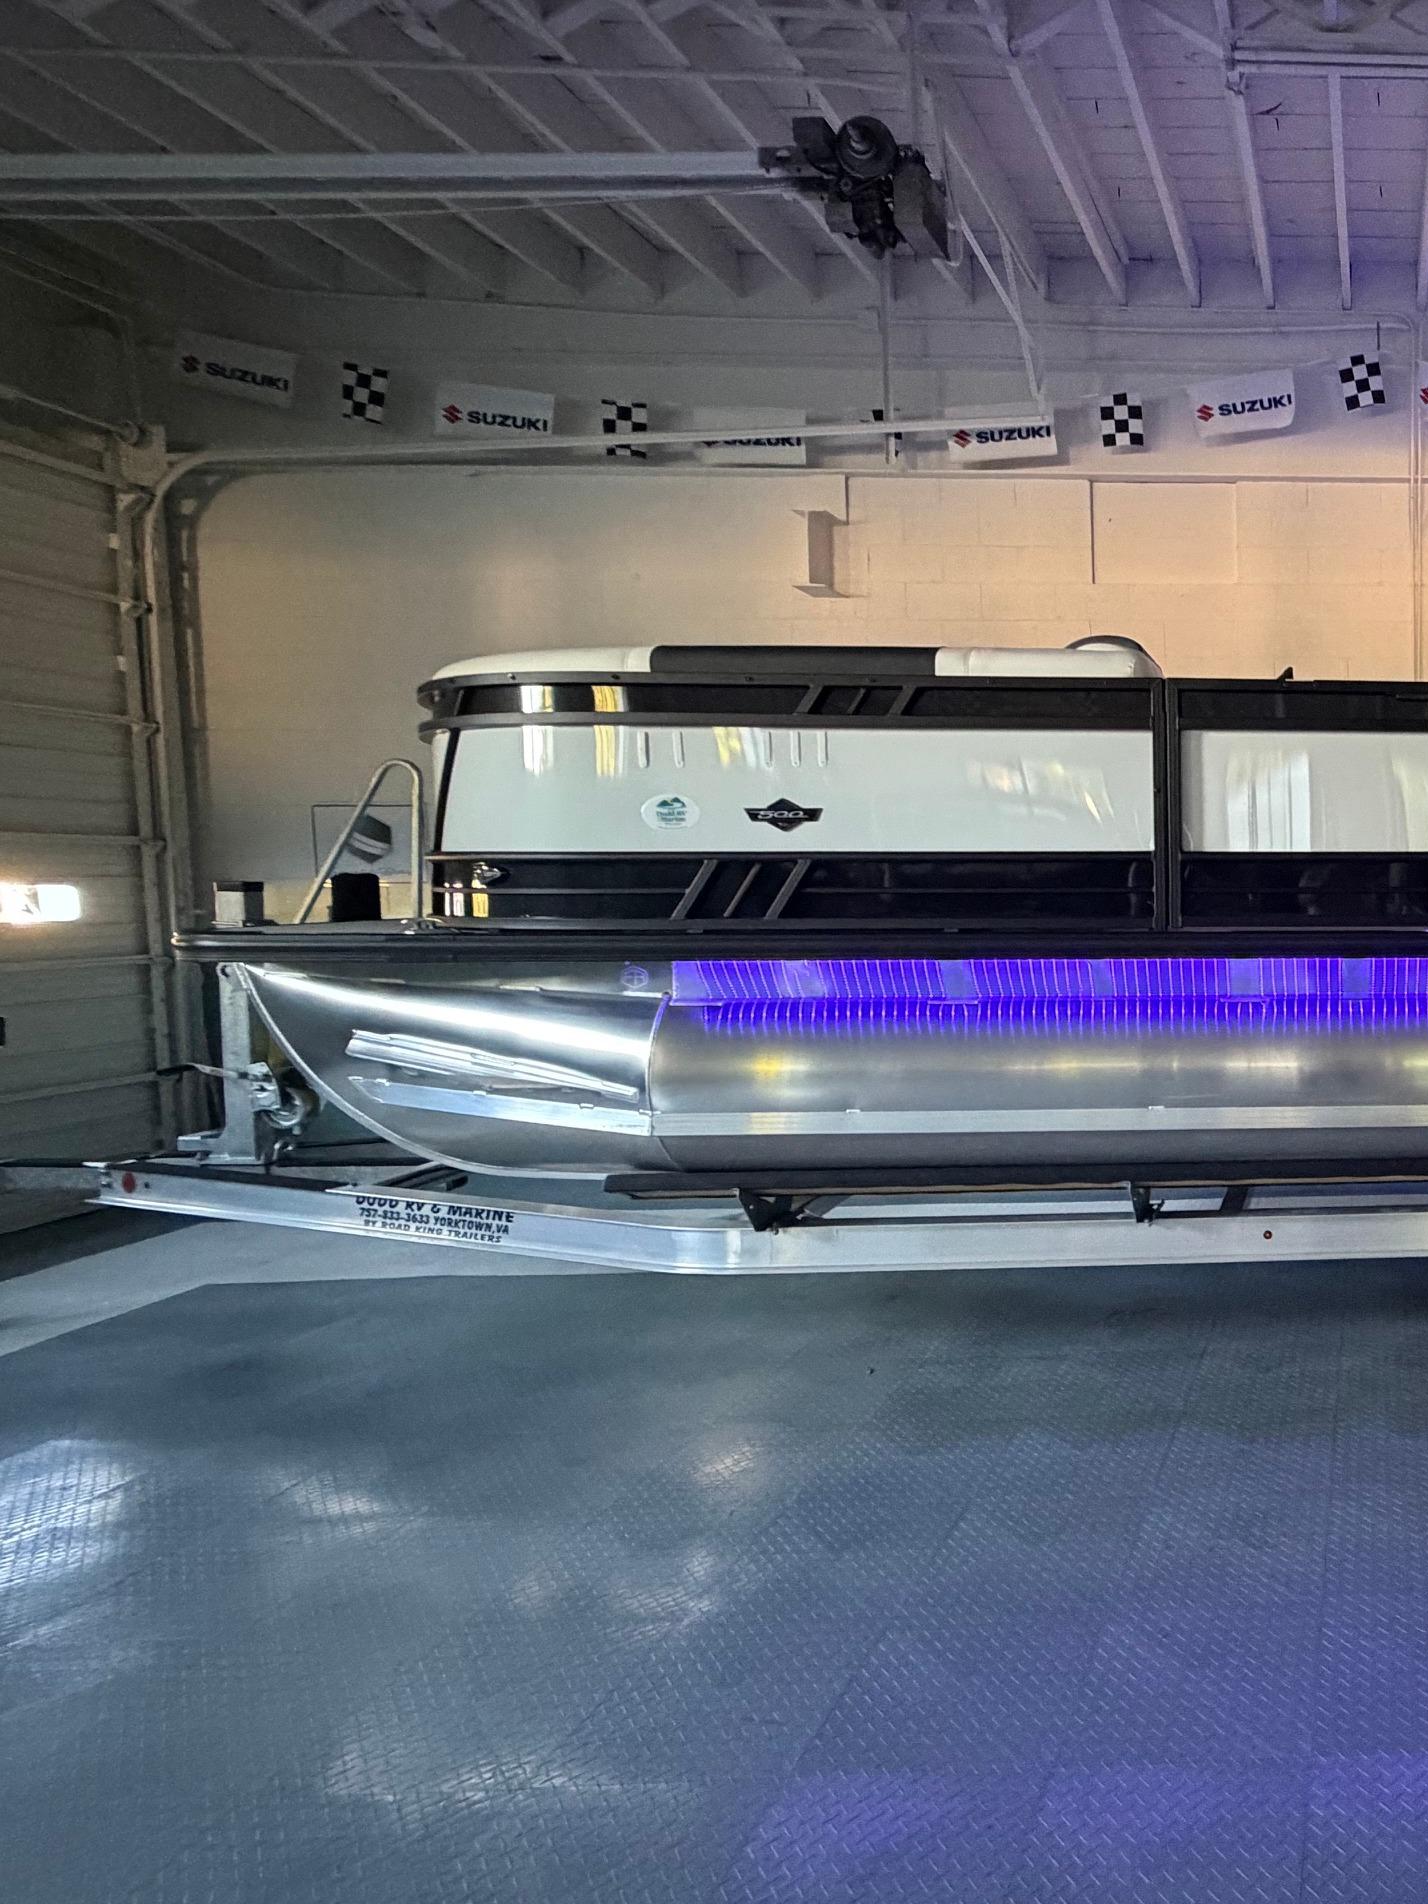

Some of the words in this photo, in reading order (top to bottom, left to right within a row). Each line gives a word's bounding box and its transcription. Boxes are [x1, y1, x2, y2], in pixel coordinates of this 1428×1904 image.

[204, 361, 290, 393] SUZUKI
[1218, 393, 1293, 417] SUZUKI
[466, 409, 549, 433] SUZUKI
[974, 424, 1052, 445] SUZUKI
[754, 810, 808, 820] 500
[404, 1200, 425, 1212] RV
[447, 1205, 515, 1223] MARINE
[364, 1218, 378, 1228] BY
[381, 1221, 411, 1232] ROAD
[414, 1225, 443, 1236] KING
[446, 1229, 503, 1243] TRAILERS
